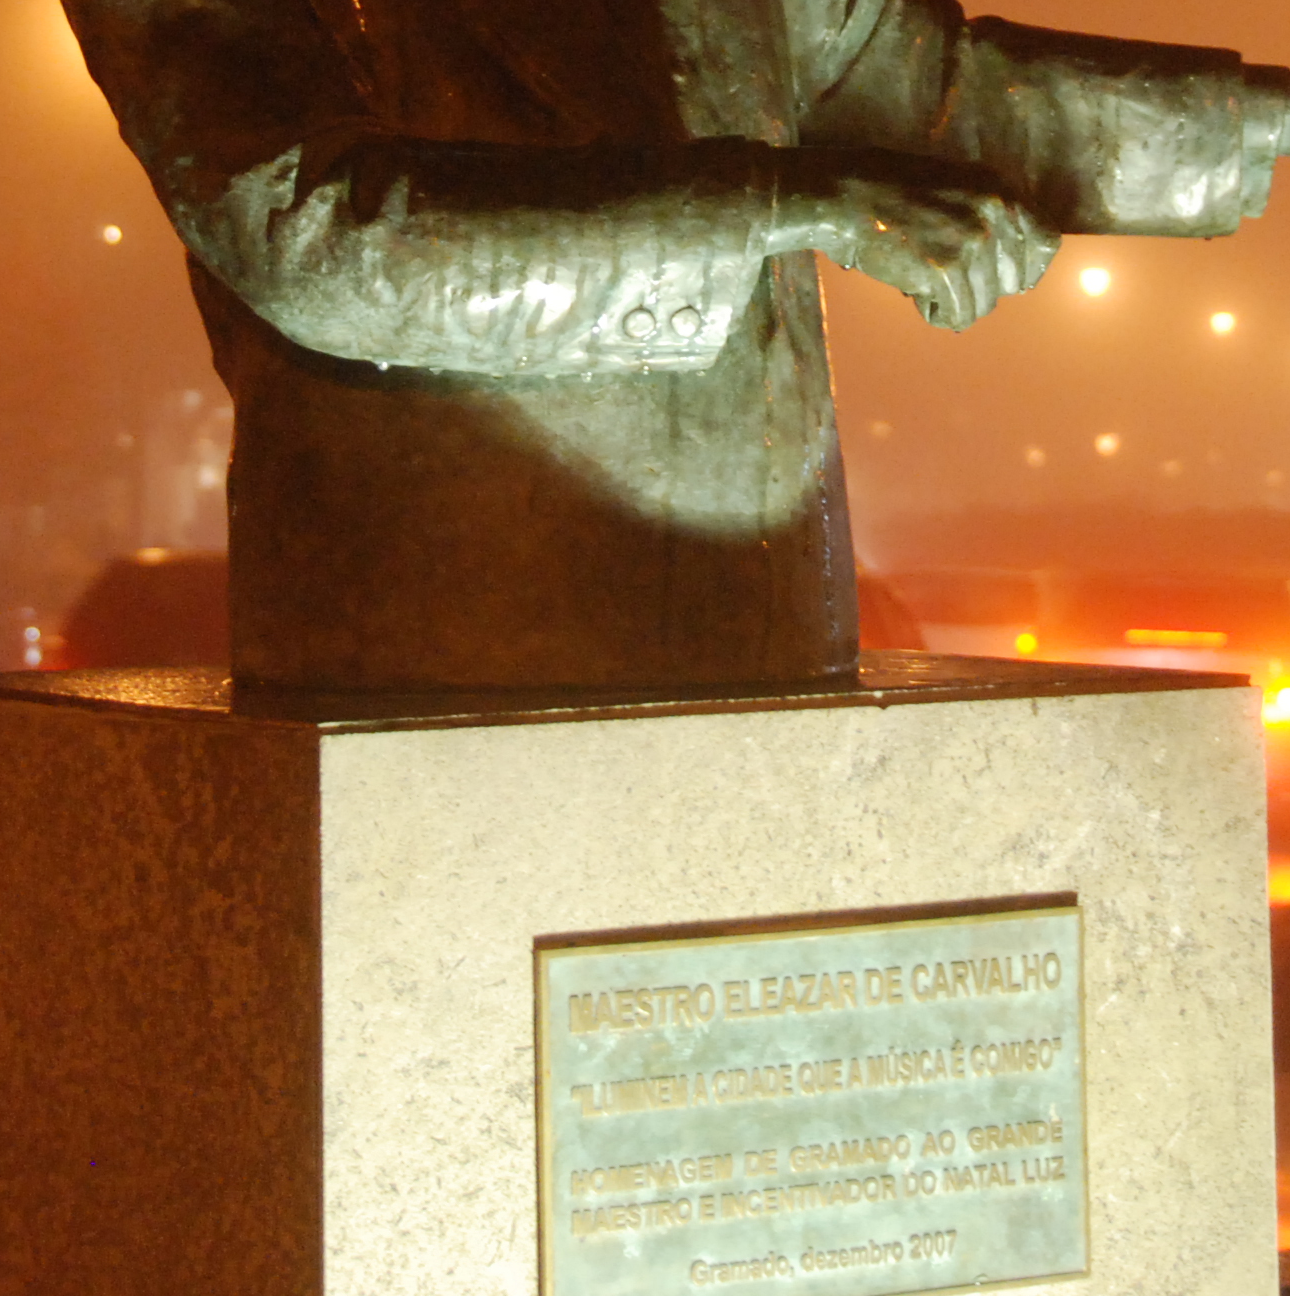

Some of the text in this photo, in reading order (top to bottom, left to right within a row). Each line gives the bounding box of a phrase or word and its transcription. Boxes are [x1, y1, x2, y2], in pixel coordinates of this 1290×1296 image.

[569, 952, 1063, 1033] MAESTRO ELEAZAR DE CARVALHO
[693, 1072, 708, 1107] A
[713, 1063, 794, 1104] CIDADE
[798, 1058, 844, 1097] QUE
[850, 1056, 864, 1088] A
[866, 1046, 948, 1087] MÚSICA
[951, 1039, 965, 1080] É
[571, 1118, 1064, 1197] HOMENAGEM DE GRAMADO AO GRANDE
[571, 1155, 1067, 1238] MAESTRO E INCENTIVADOR DO NATAL LUZ
[690, 1229, 958, 1287] Gramado, dezembro 2007
